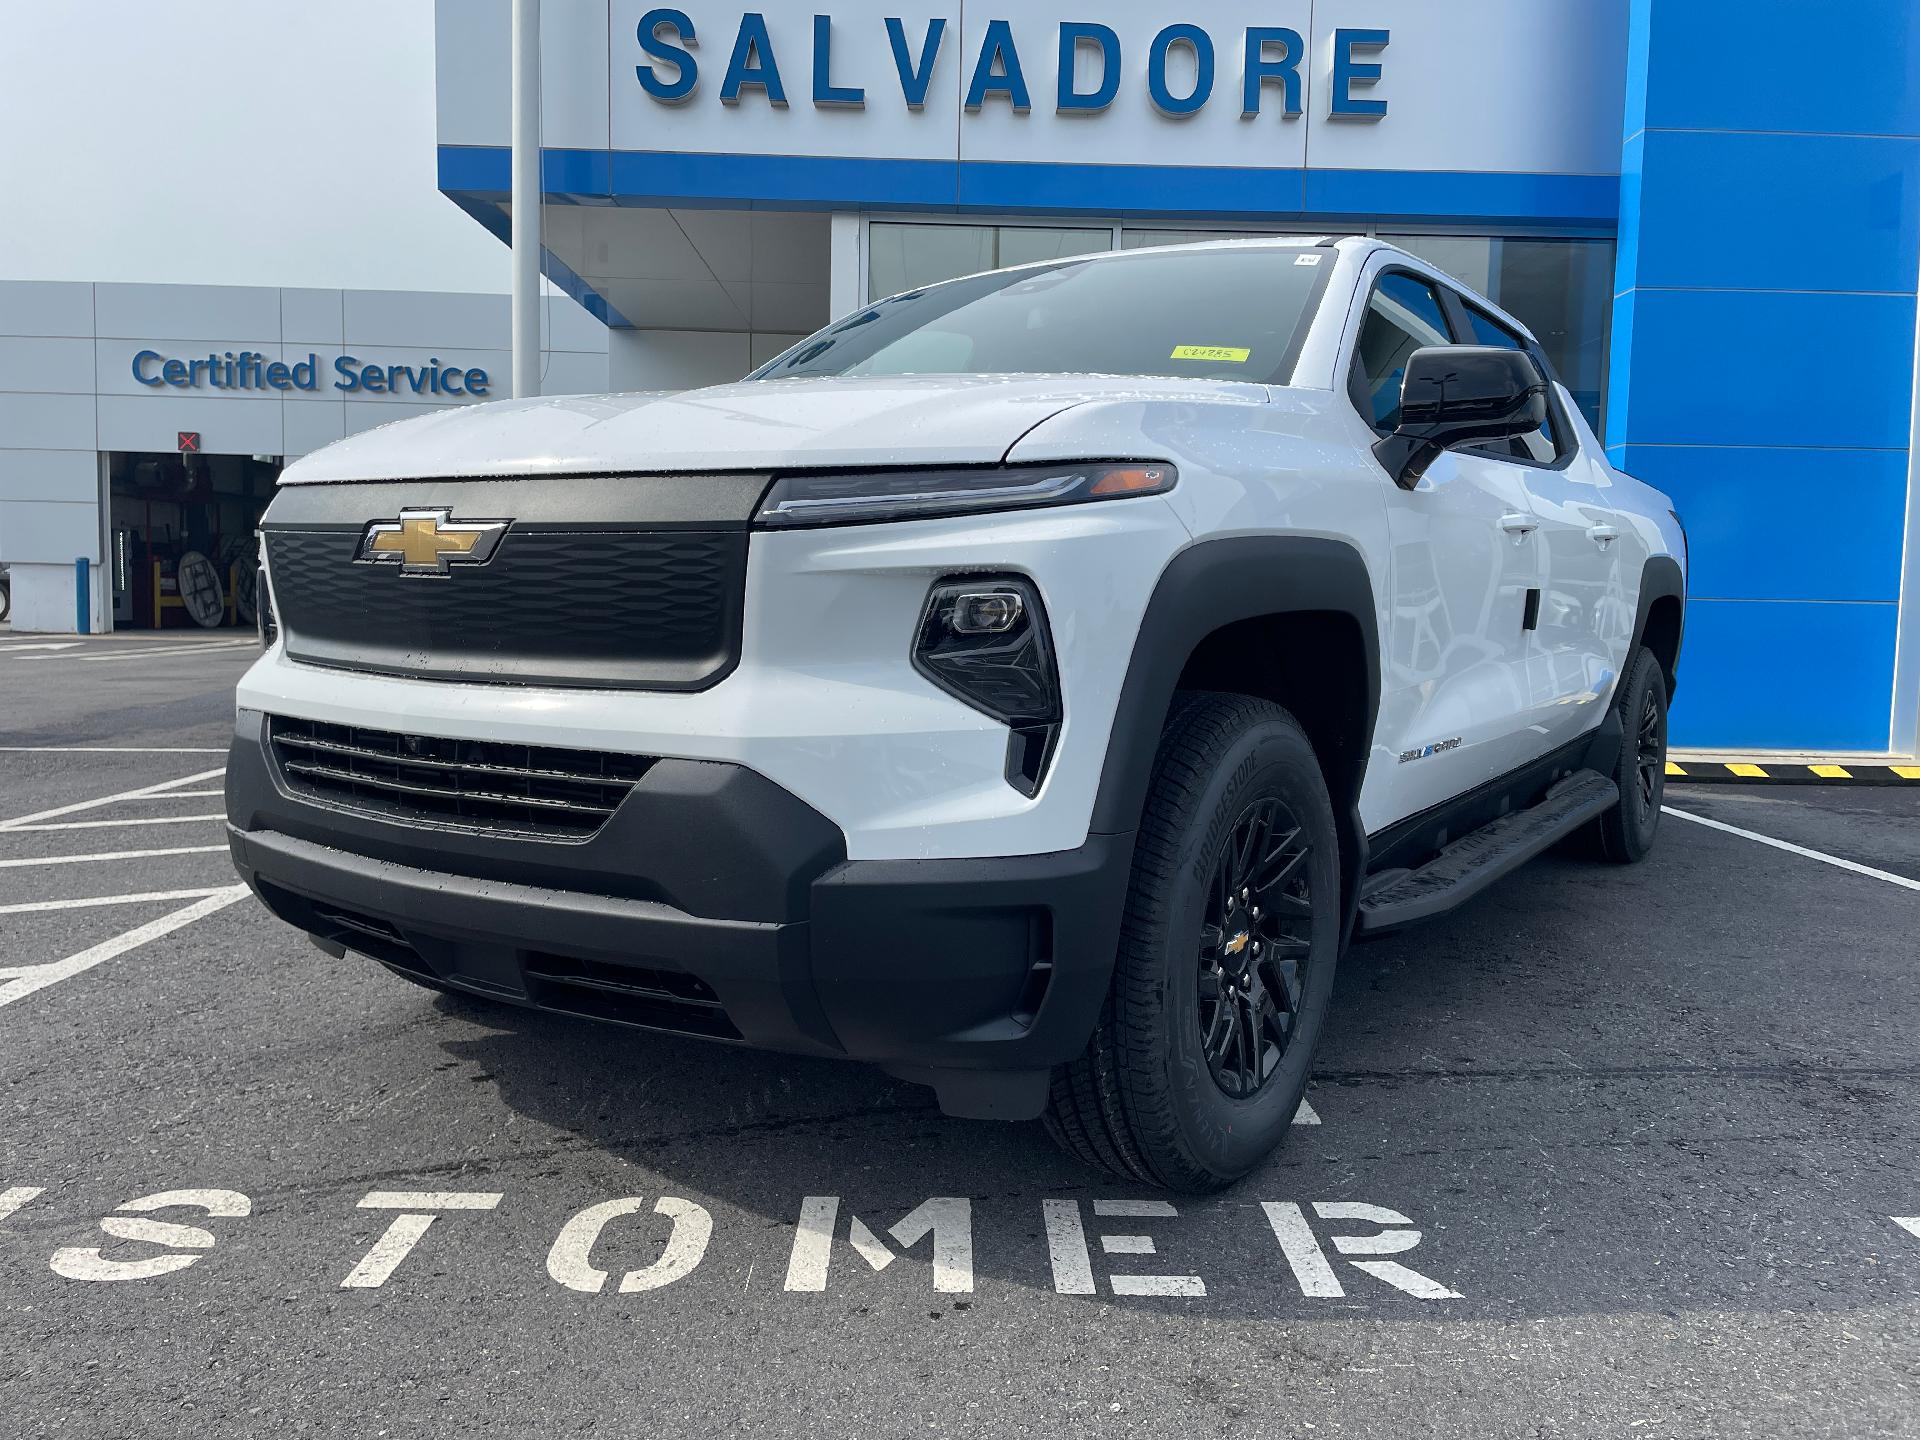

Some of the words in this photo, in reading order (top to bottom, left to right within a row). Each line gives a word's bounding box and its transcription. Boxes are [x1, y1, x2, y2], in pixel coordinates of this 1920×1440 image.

[635, 8, 1390, 121] SALVADORE
[131, 350, 320, 391] Certified
[334, 356, 491, 396] Service
